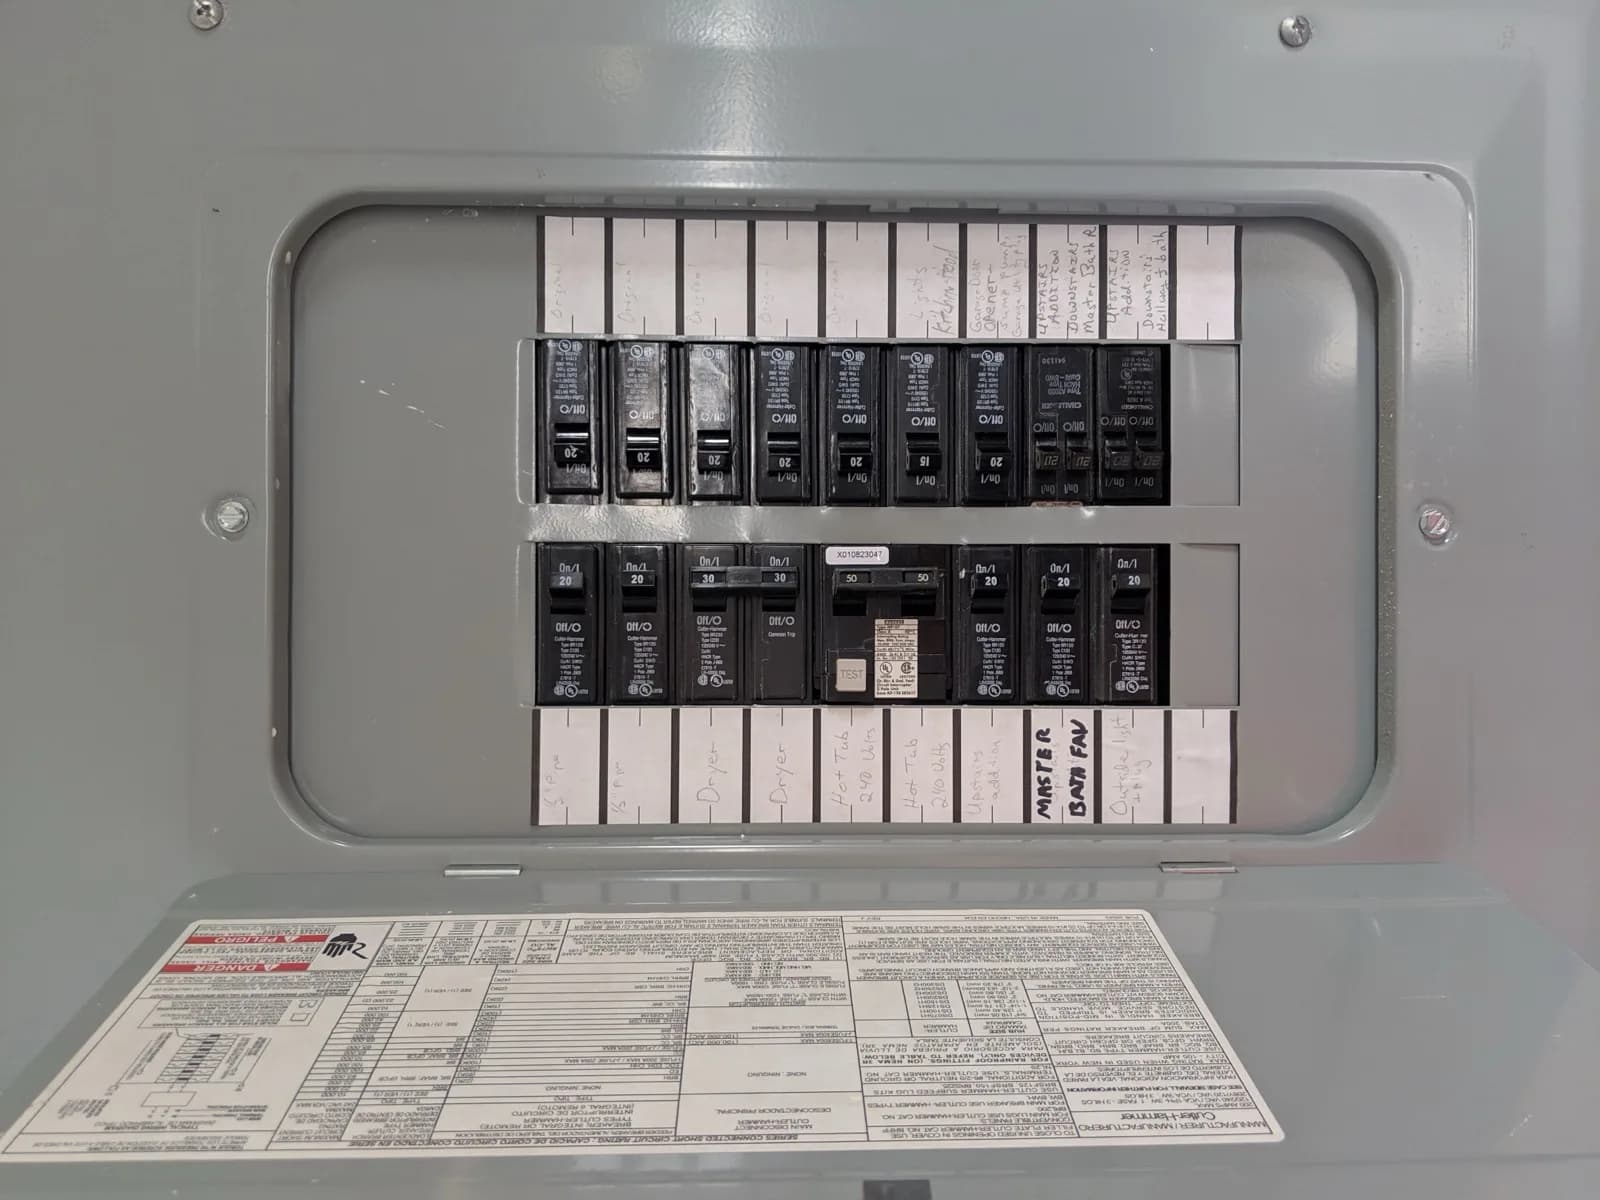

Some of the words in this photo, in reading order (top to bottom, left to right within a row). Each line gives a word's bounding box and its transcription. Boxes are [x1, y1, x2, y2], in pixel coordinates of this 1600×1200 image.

[1083, 227, 1097, 237] R
[1152, 231, 1167, 261] bath
[1080, 242, 1095, 277] Bath
[1048, 250, 1059, 324] ADDITION
[1068, 242, 1078, 333] DOWNSTAIRS
[1082, 283, 1096, 333] Master
[565, 448, 577, 458] 20
[637, 452, 650, 462] 20
[708, 455, 720, 465] 20
[779, 457, 791, 467] 20
[851, 457, 862, 467] 20
[920, 456, 929, 466] 15
[990, 457, 1003, 466] 20
[559, 577, 571, 585] 20
[631, 575, 643, 584] 20
[702, 574, 714, 582] 30
[774, 573, 786, 582] 30
[918, 573, 929, 581] 50
[985, 577, 997, 586] 20
[1058, 577, 1069, 587] 20
[1128, 576, 1140, 585] 20
[840, 670, 863, 679] TEST
[834, 731, 849, 763] Tub
[904, 739, 919, 773] Tub
[696, 742, 728, 803] Dryer
[769, 744, 793, 805] Dryer
[1036, 728, 1052, 819] MASTER
[831, 770, 850, 807] Hot
[859, 770, 873, 803] 240
[903, 782, 920, 808] Hot
[931, 779, 949, 808] 240
[1068, 767, 1086, 817] BATH
[1117, 1111, 1217, 1121] Cutler-Hammer
